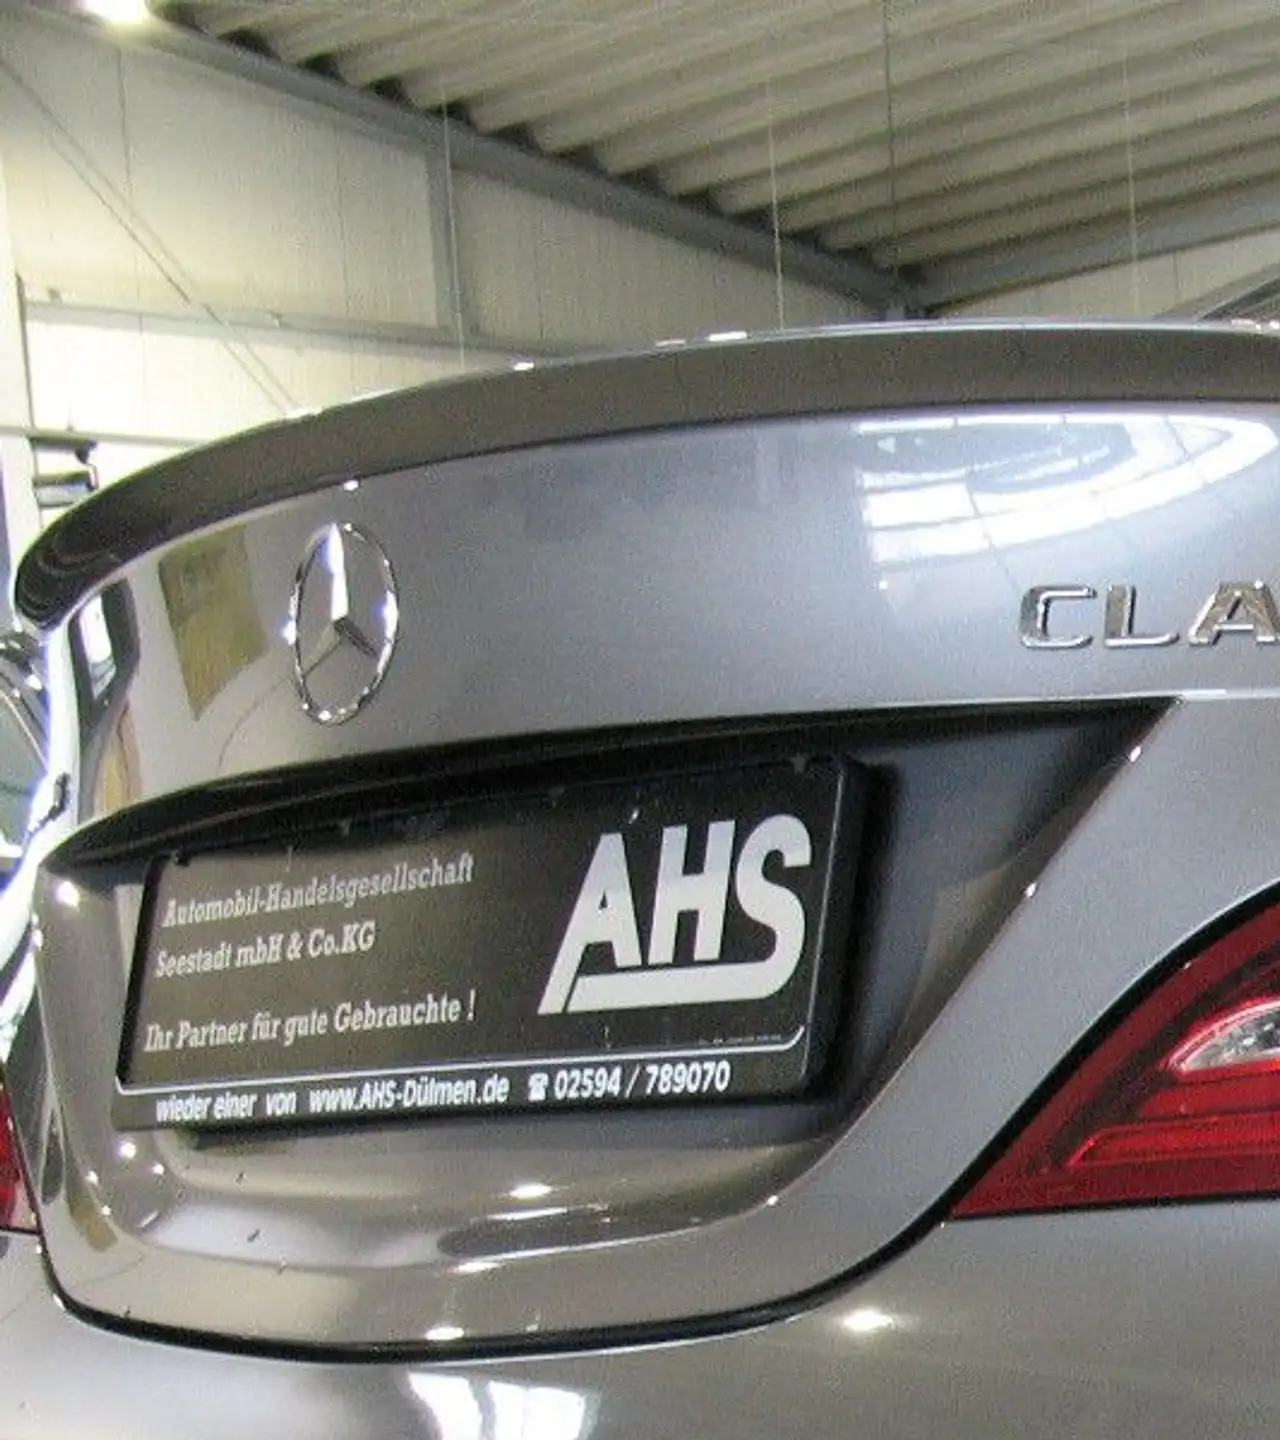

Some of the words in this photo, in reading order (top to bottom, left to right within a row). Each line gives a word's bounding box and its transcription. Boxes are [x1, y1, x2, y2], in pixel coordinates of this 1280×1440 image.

[161, 852, 474, 928] Automobil-Handelsgesellschaft
[537, 813, 812, 1015] AHS
[155, 941, 233, 978] Seestadt
[235, 932, 284, 968] mbH
[286, 930, 304, 961] &
[308, 919, 376, 958] Co.KG
[144, 1022, 174, 1052] Ihr
[176, 1018, 248, 1049] Partner
[251, 1010, 282, 1042] für
[283, 1007, 329, 1047] gute
[334, 992, 462, 1033] Gebrauchte
[466, 987, 477, 1022] !
[156, 1093, 213, 1123] wieder
[213, 1090, 259, 1120] einer
[265, 1090, 297, 1116] von
[308, 1072, 511, 1114] www.AHS-Dülmen.de
[554, 1065, 622, 1100] 02594
[646, 1059, 732, 1095] 789070
